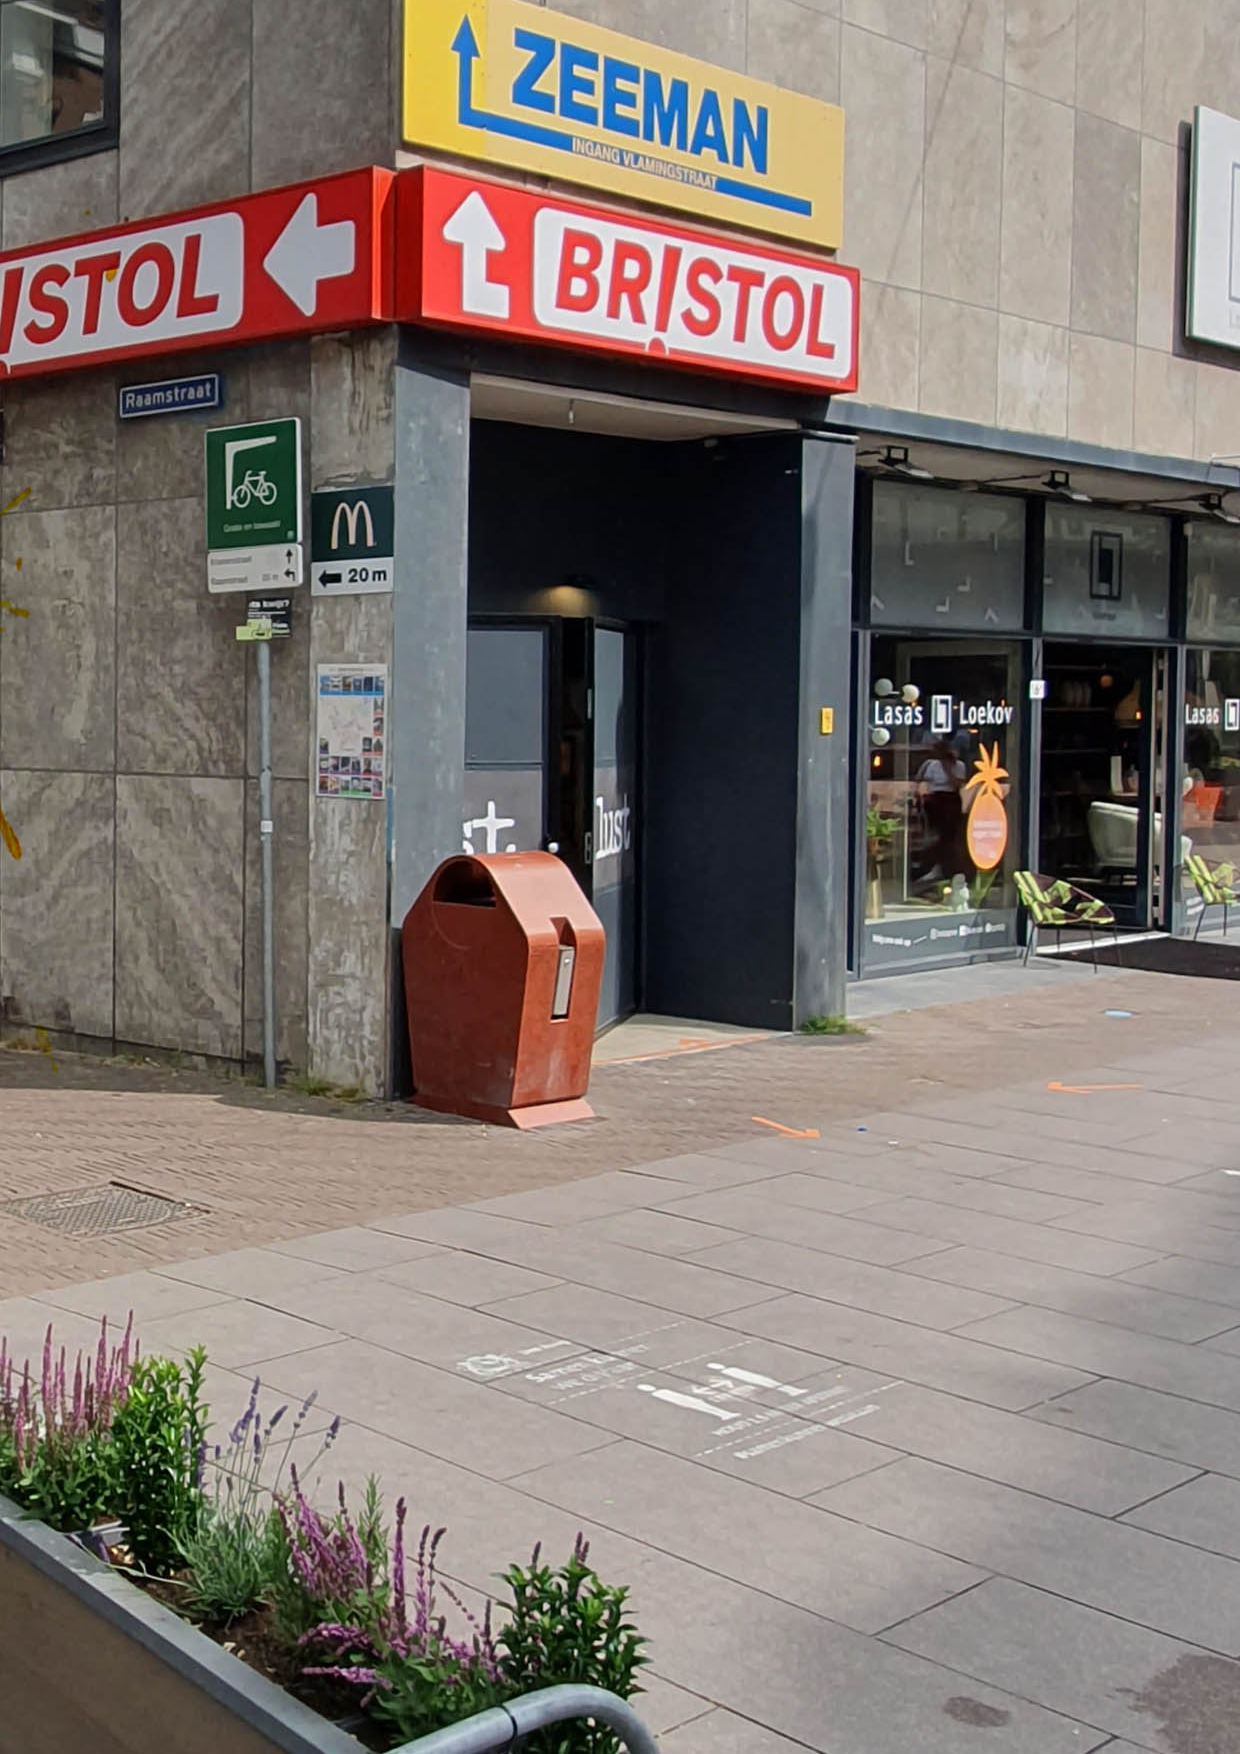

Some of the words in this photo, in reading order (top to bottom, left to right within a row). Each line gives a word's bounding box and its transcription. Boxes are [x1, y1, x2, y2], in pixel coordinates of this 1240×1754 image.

[512, 27, 768, 175] ZEEMAN
[572, 137, 620, 164] INGANG
[623, 151, 718, 190] VLAMINGSTRAAT
[555, 227, 835, 359] BRISTOL
[125, 381, 212, 408] Raamstraat
[348, 567, 369, 583] 20
[372, 570, 387, 582] m
[875, 700, 923, 725] Lasas
[960, 700, 1013, 725] Loekov
[1185, 703, 1220, 725] Lasas
